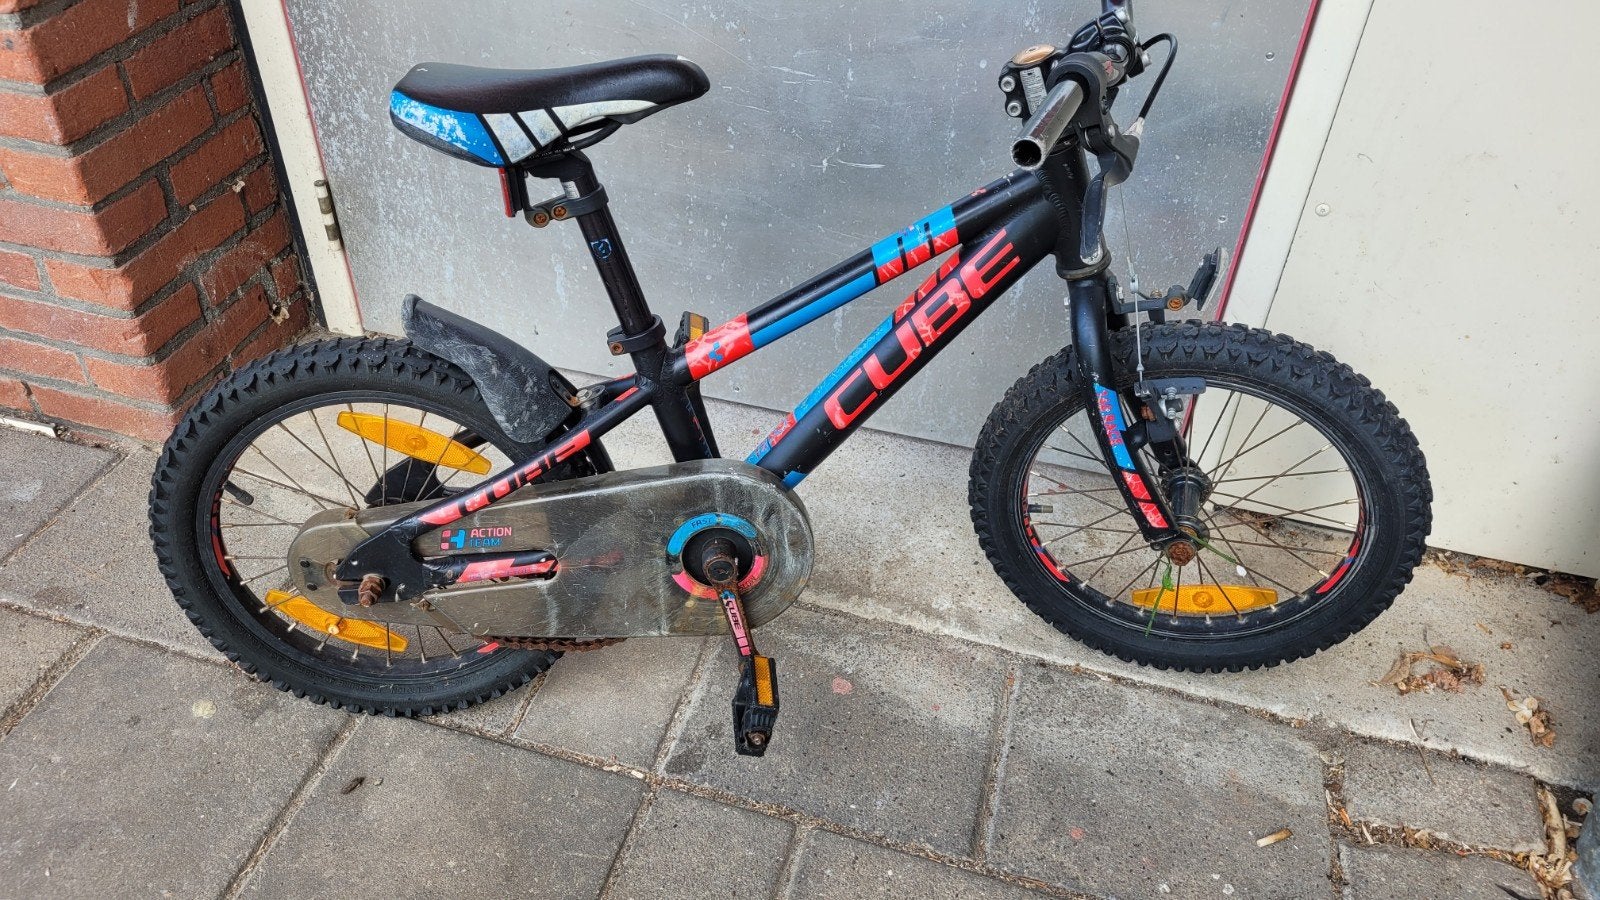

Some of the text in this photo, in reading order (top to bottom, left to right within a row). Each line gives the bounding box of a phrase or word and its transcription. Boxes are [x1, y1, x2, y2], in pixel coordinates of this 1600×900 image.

[823, 228, 1021, 431] CUBE
[690, 517, 713, 528] FAST
[470, 527, 512, 538] ACTION
[469, 538, 502, 548] TEAM
[725, 600, 742, 630] CUBE
